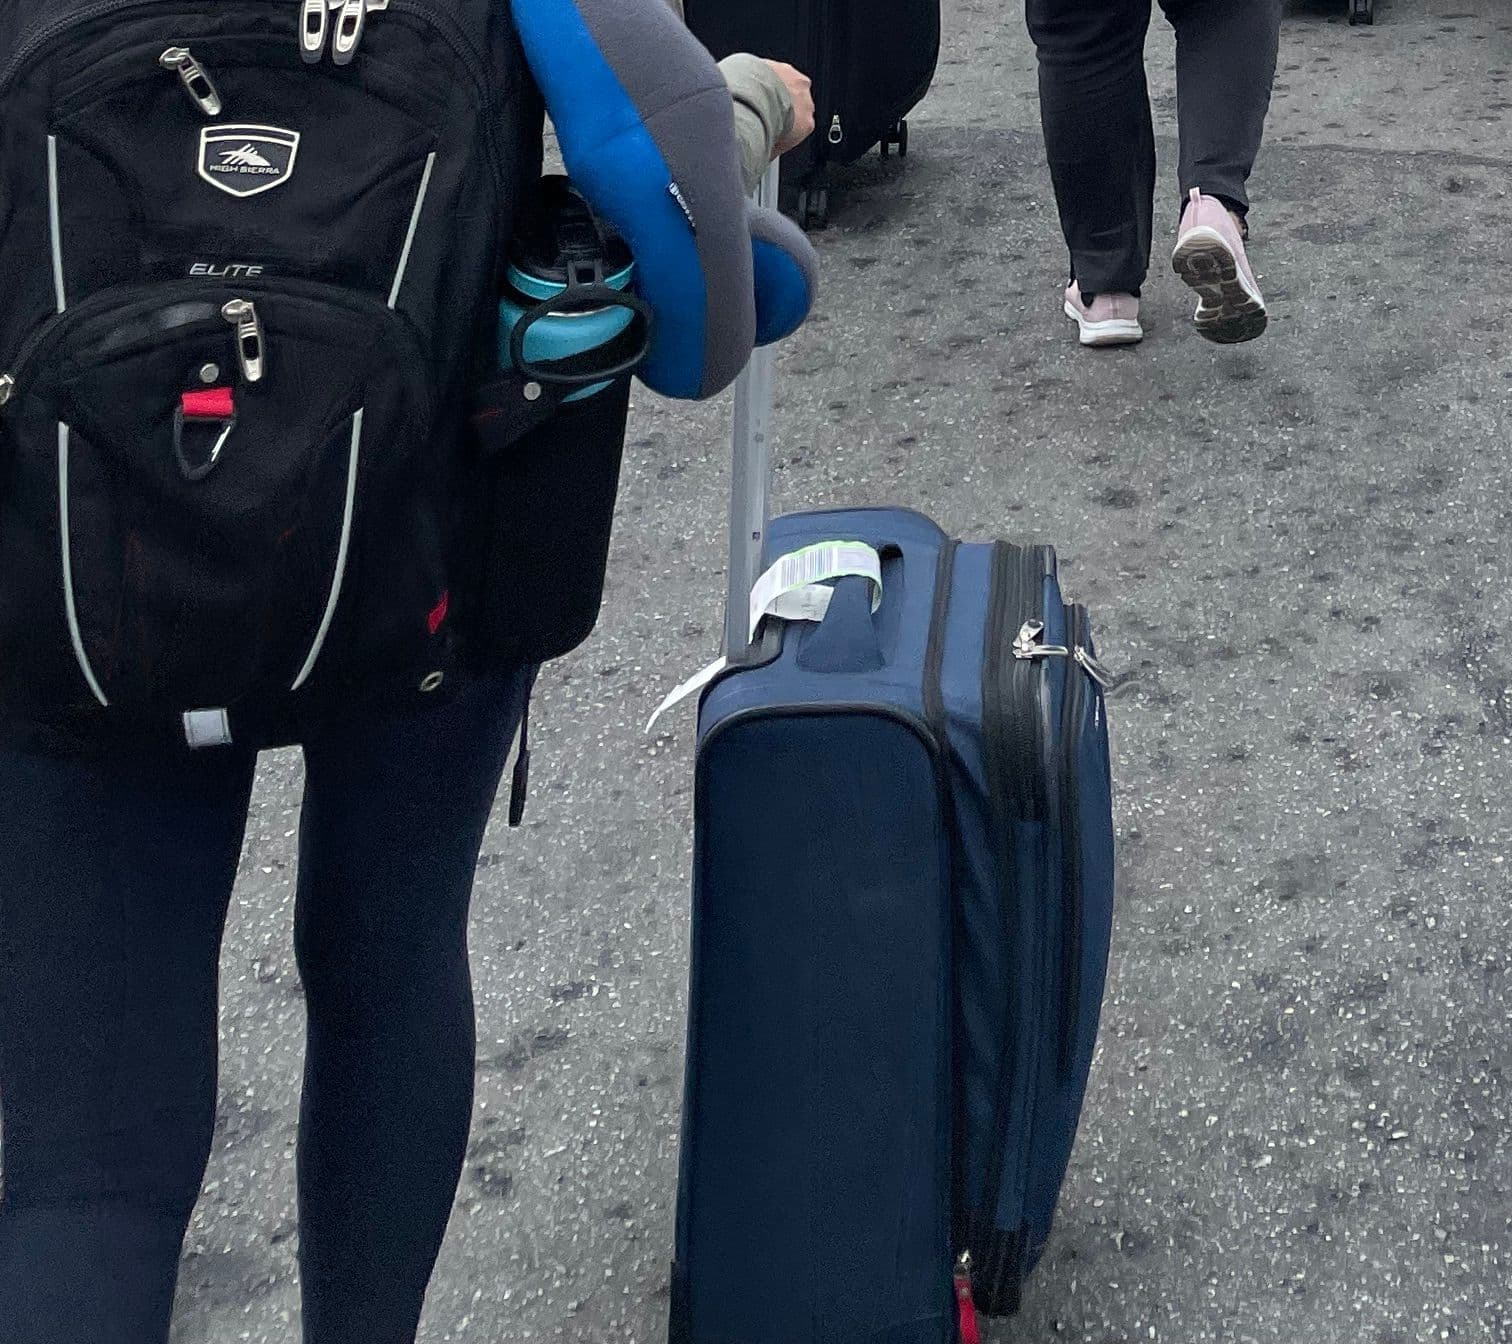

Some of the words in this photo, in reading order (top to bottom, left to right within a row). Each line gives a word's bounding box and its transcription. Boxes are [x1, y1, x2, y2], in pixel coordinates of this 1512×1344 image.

[210, 165, 239, 173] HIGH
[239, 166, 280, 174] SIERRA
[189, 262, 263, 277] ELITE
